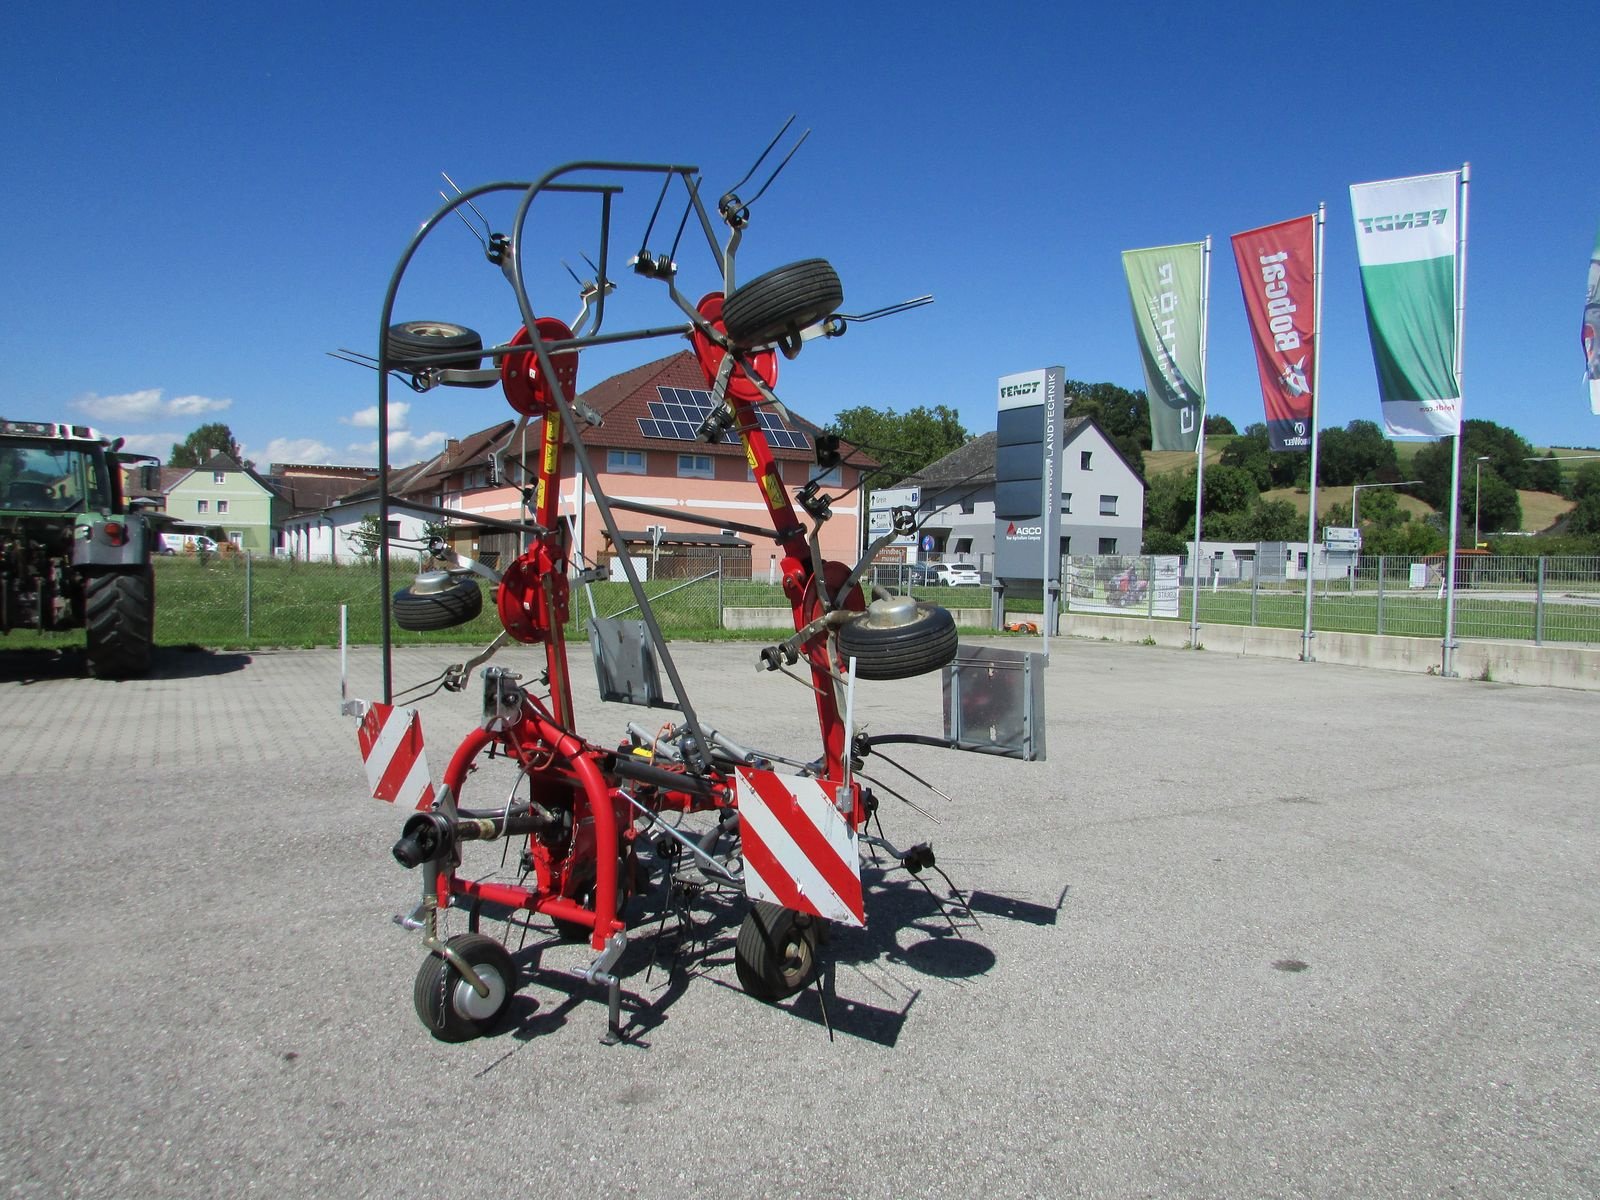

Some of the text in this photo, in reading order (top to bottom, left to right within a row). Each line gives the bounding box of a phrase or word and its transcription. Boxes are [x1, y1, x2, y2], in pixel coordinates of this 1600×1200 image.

[1000, 381, 1041, 398] FENDT
[1045, 373, 1056, 457] LANDTECHNIK
[1016, 527, 1042, 535] AGCO
